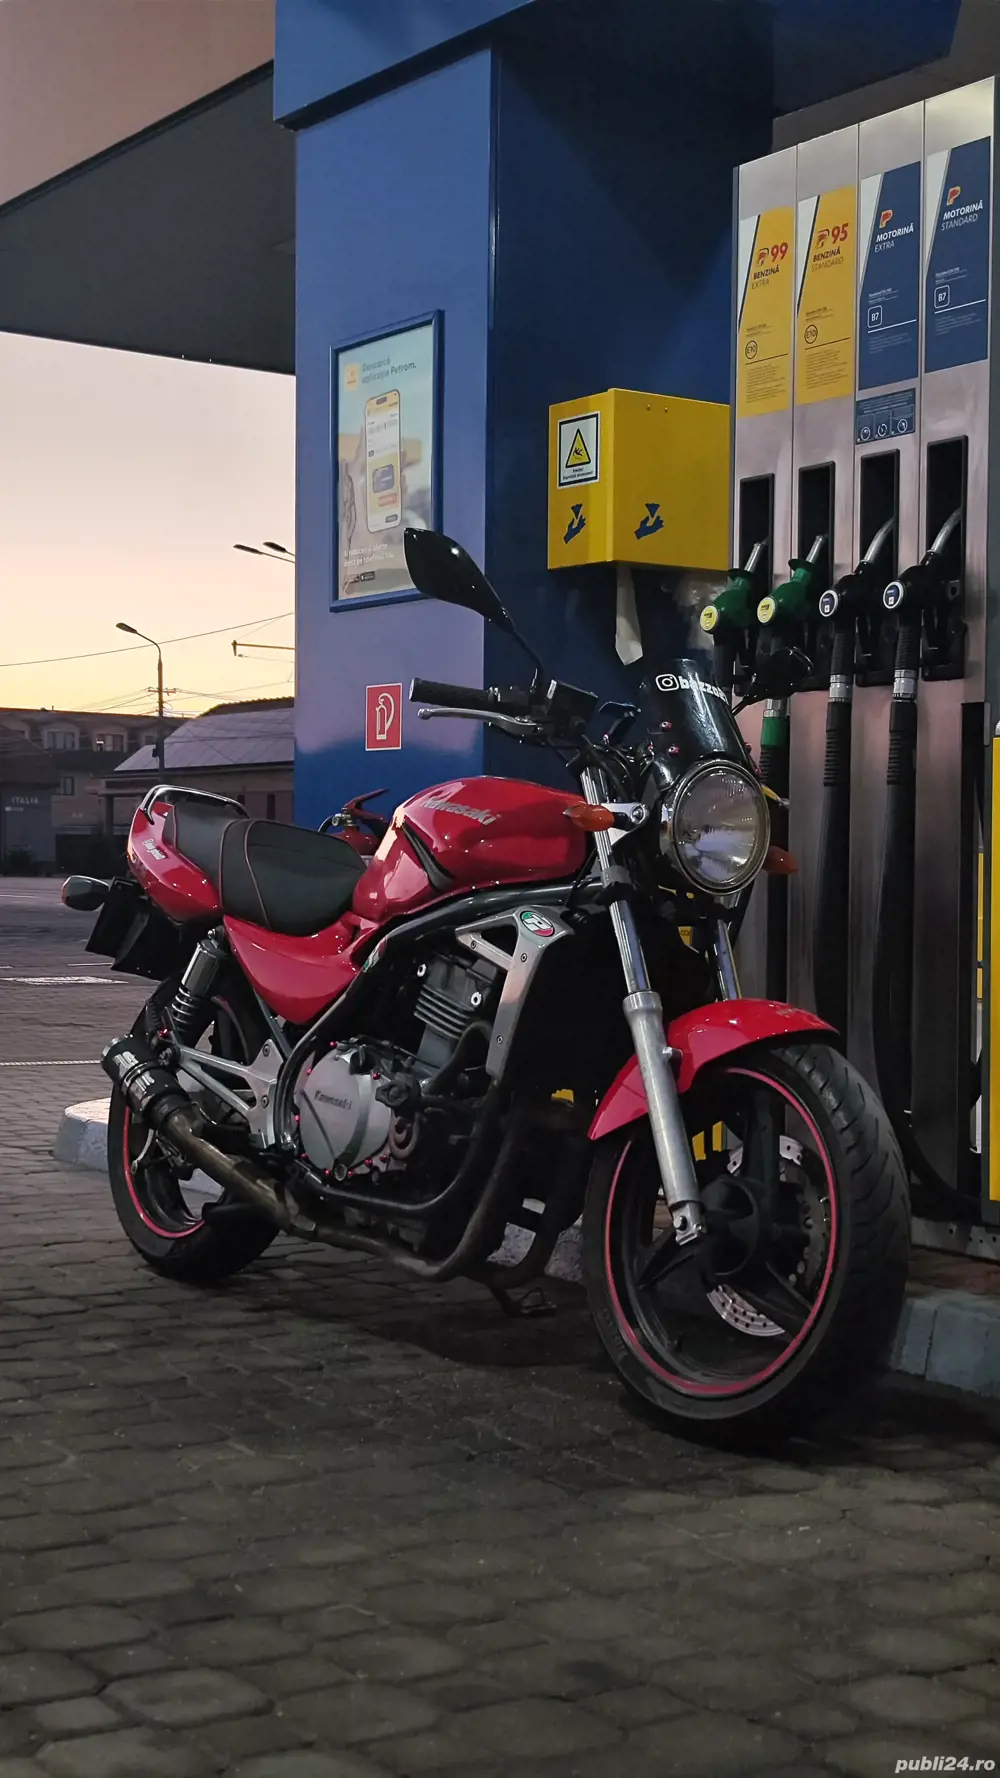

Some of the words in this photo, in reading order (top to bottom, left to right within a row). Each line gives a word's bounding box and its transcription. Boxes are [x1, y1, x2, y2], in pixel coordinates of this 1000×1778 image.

[943, 199, 984, 221] MOTORINĂ
[941, 213, 979, 232] STANDARD
[831, 222, 849, 244] 95
[875, 222, 914, 243] MOTORINĂ
[770, 241, 789, 263] 99
[812, 246, 841, 263] BENZINĂ
[874, 240, 895, 253] EXTRA
[753, 265, 780, 280] BENZINĂ
[811, 256, 844, 272] STANDARD
[751, 278, 770, 290] EXTRA
[938, 292, 947, 302] B7
[871, 312, 880, 322] B7
[421, 797, 500, 826] Kawasaki
[314, 1090, 353, 1110] Kawasaki
